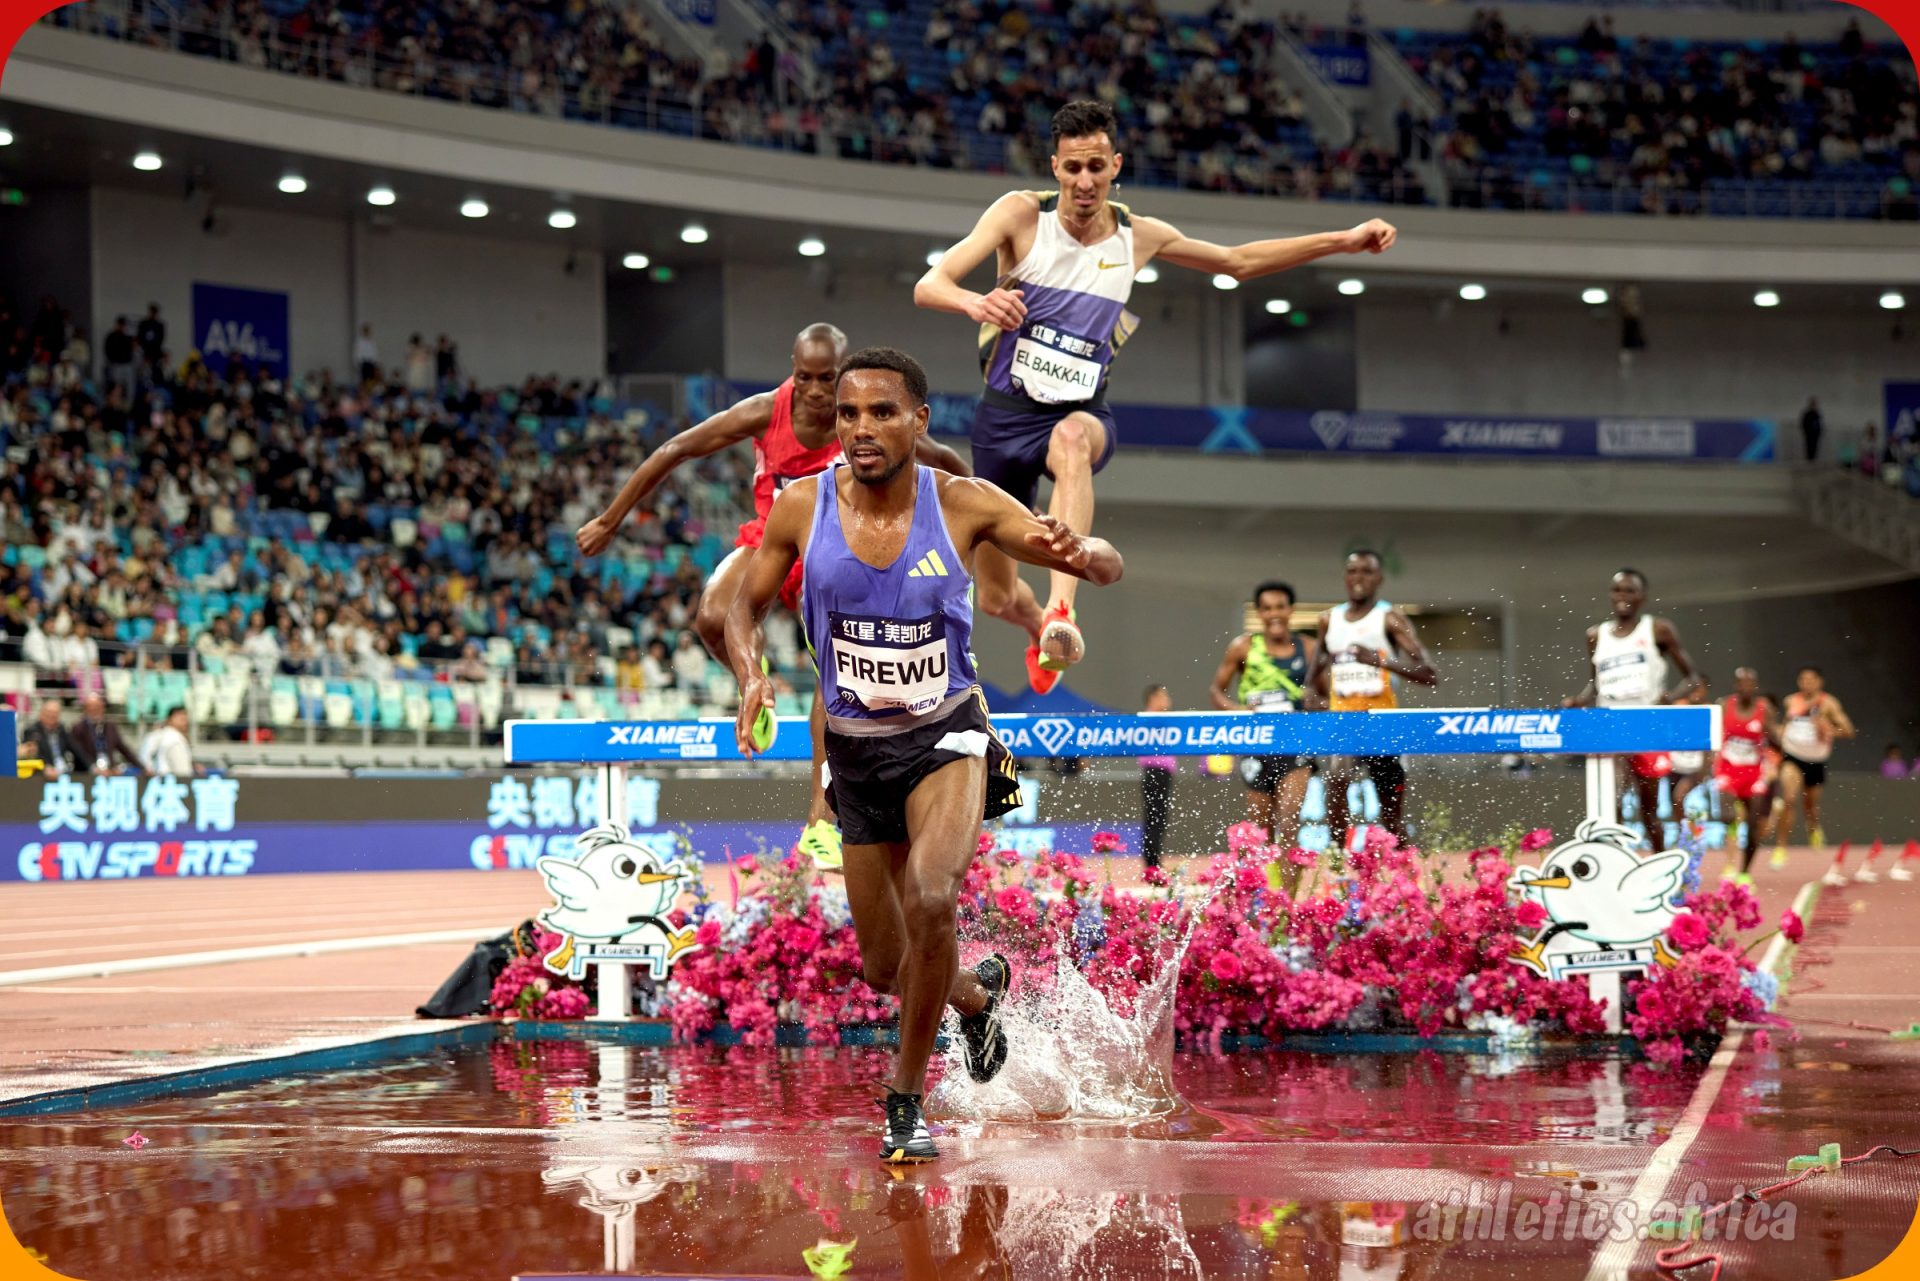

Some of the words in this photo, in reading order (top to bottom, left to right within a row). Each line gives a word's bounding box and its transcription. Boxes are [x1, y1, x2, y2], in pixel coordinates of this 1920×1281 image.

[1016, 349, 1030, 367] EL
[1032, 356, 1095, 388] BAKKALI
[1441, 420, 1563, 449] XIAMEN
[842, 619, 932, 643] 红星·美凯龙
[836, 650, 946, 685] FIREWU
[606, 725, 717, 745] XIAMEN
[999, 728, 1033, 748] DA
[1076, 726, 1181, 747] DIAMOND
[1185, 725, 1275, 746] LEAGUE
[1435, 714, 1561, 735] XIAMEN
[38, 773, 241, 834] 央视体育
[18, 841, 103, 881] CCTV
[100, 840, 258, 879] SPORTS
[470, 834, 546, 870] CCTV
[1574, 952, 1626, 964] XIAMEN
